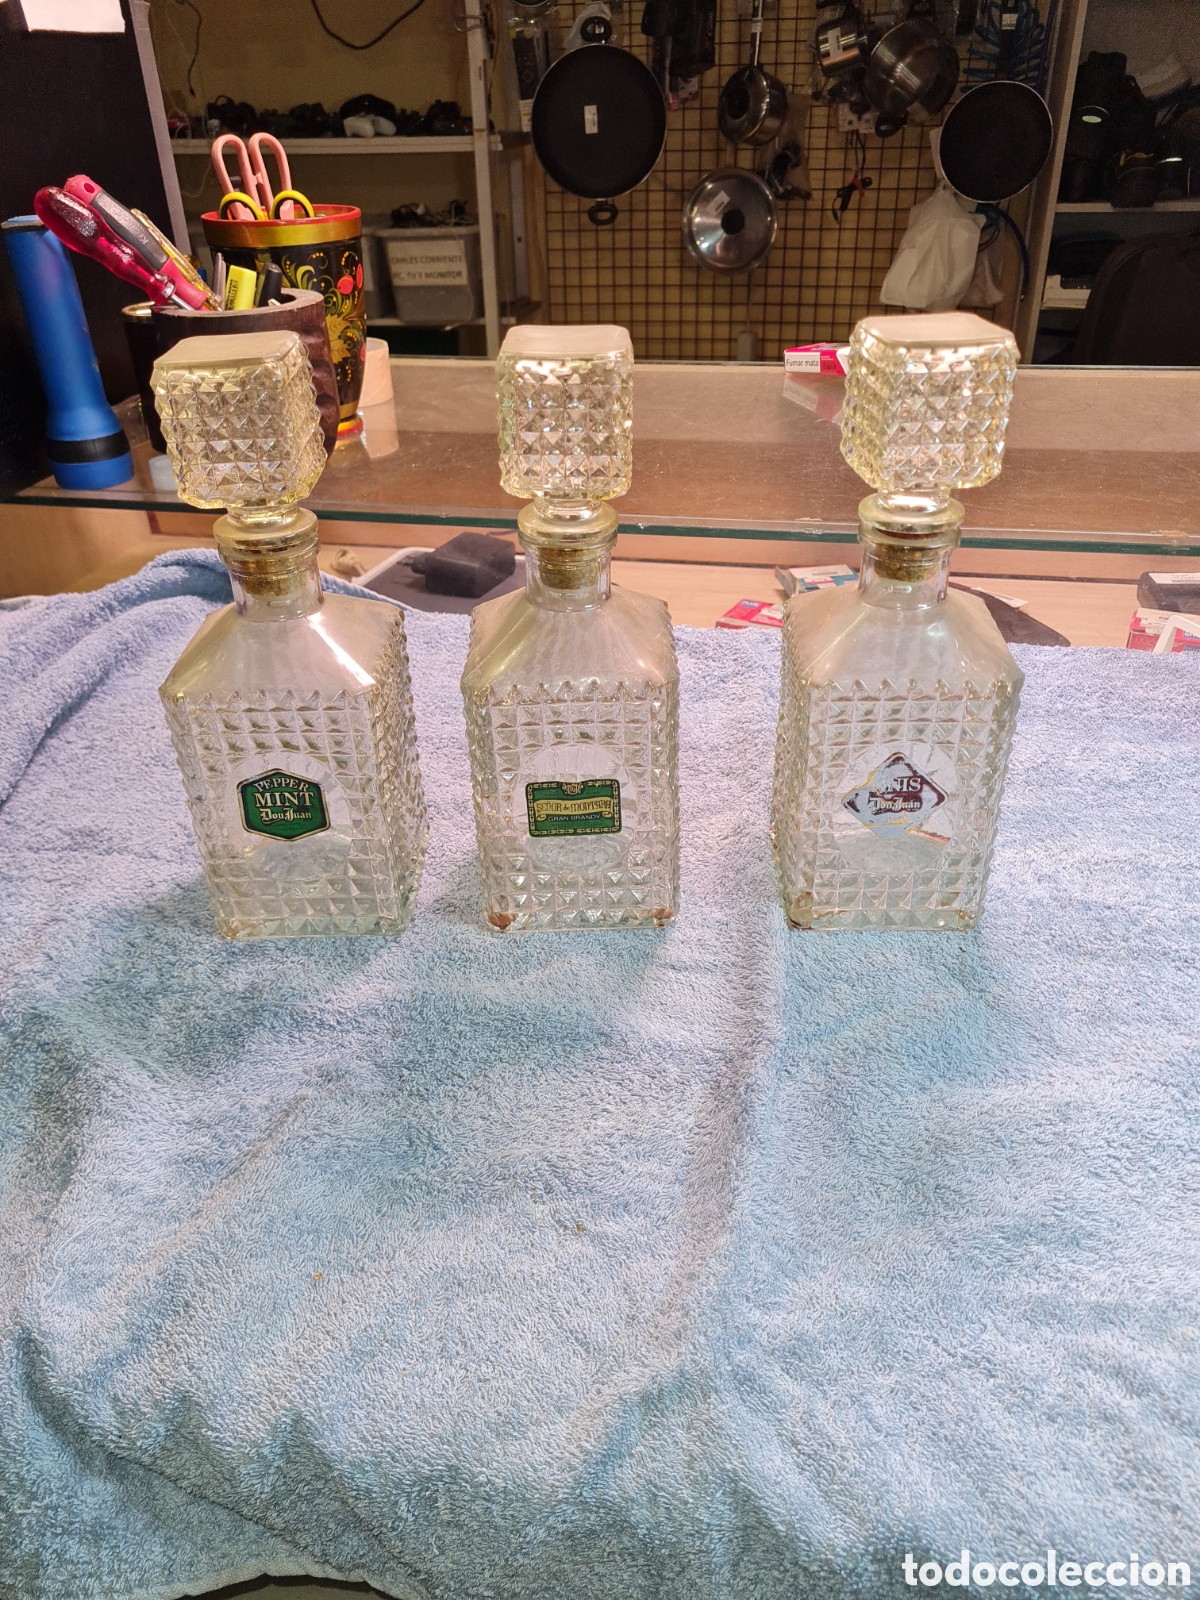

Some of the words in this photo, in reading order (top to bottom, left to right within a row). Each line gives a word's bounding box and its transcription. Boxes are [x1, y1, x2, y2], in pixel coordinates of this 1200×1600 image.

[786, 358, 803, 367] Fumar
[804, 359, 819, 367] mata
[253, 777, 309, 792] PEPPER
[253, 792, 314, 807] MINT
